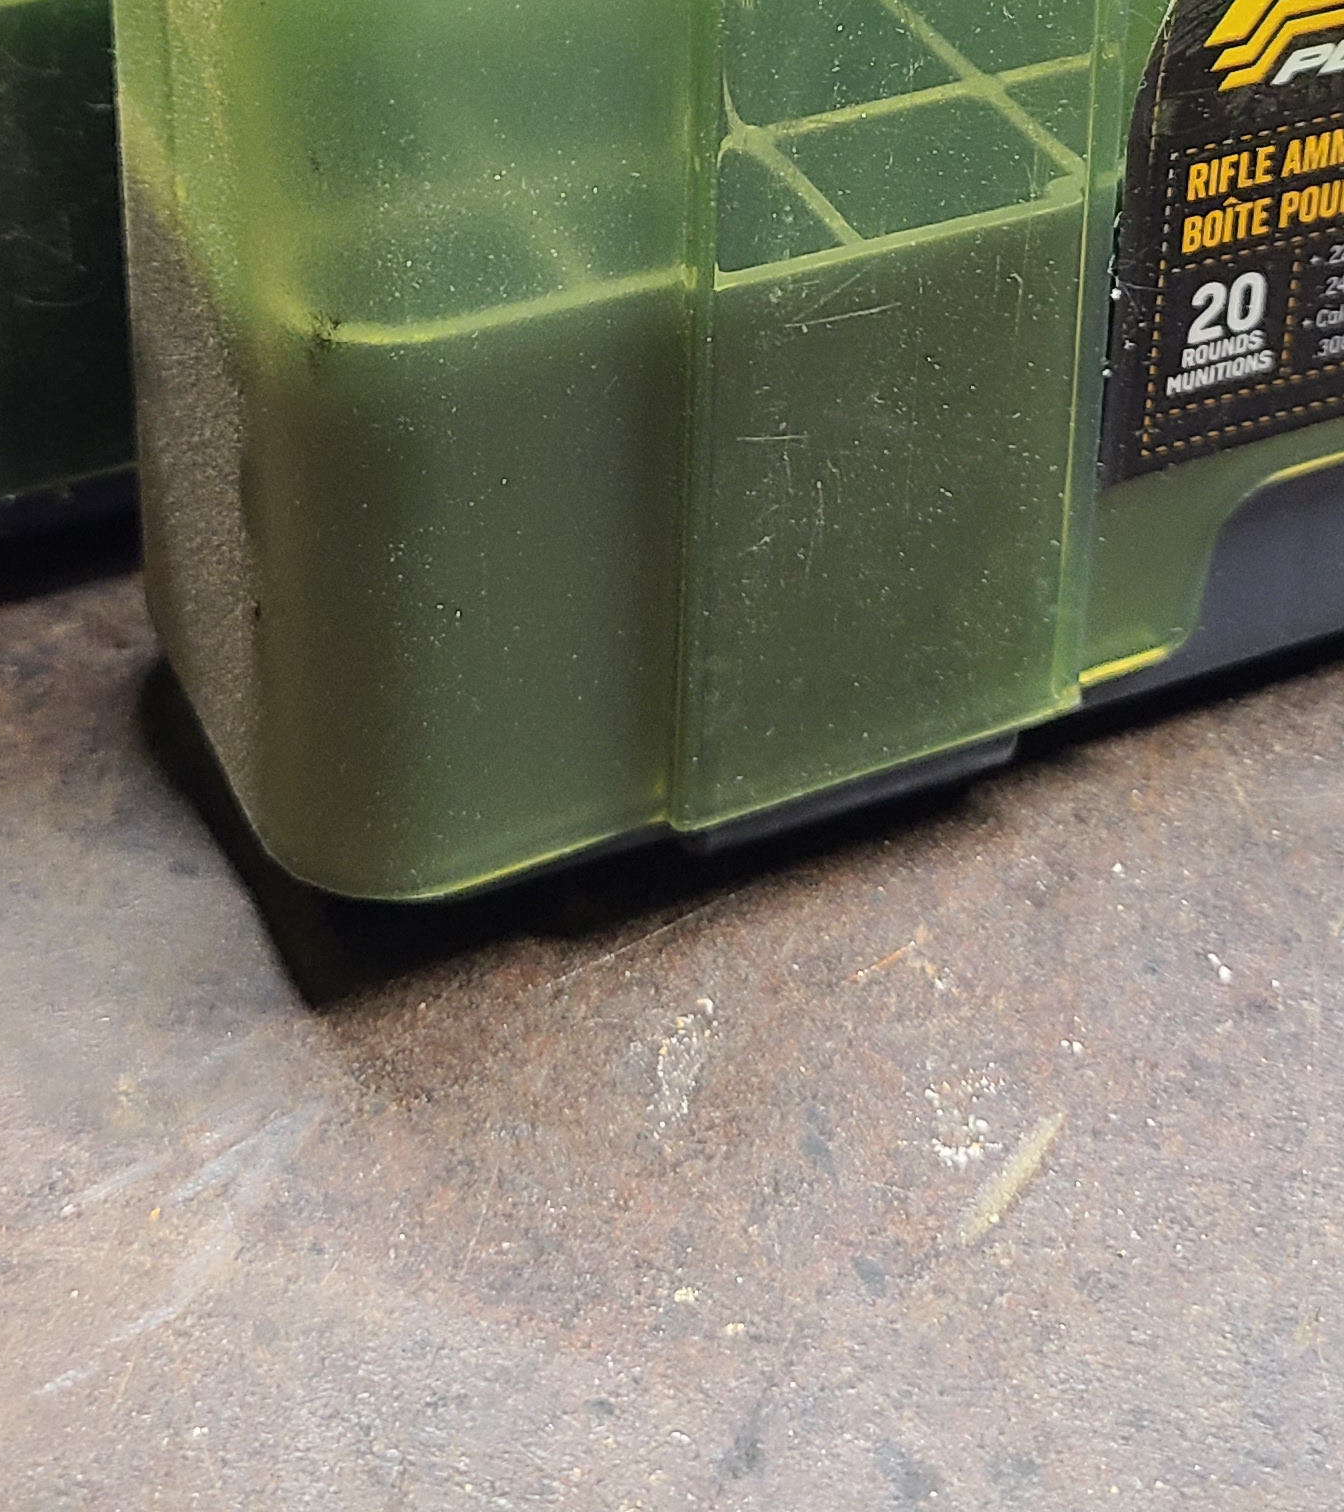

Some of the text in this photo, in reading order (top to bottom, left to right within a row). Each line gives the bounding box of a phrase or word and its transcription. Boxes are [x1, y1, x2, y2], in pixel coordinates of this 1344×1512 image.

[1186, 145, 1276, 202] RIFLE
[1180, 196, 1273, 254] BOÎTE
[1187, 271, 1267, 344] 20
[1166, 350, 1275, 396] MUNITIONS
[1181, 330, 1266, 369] ROUNDS
